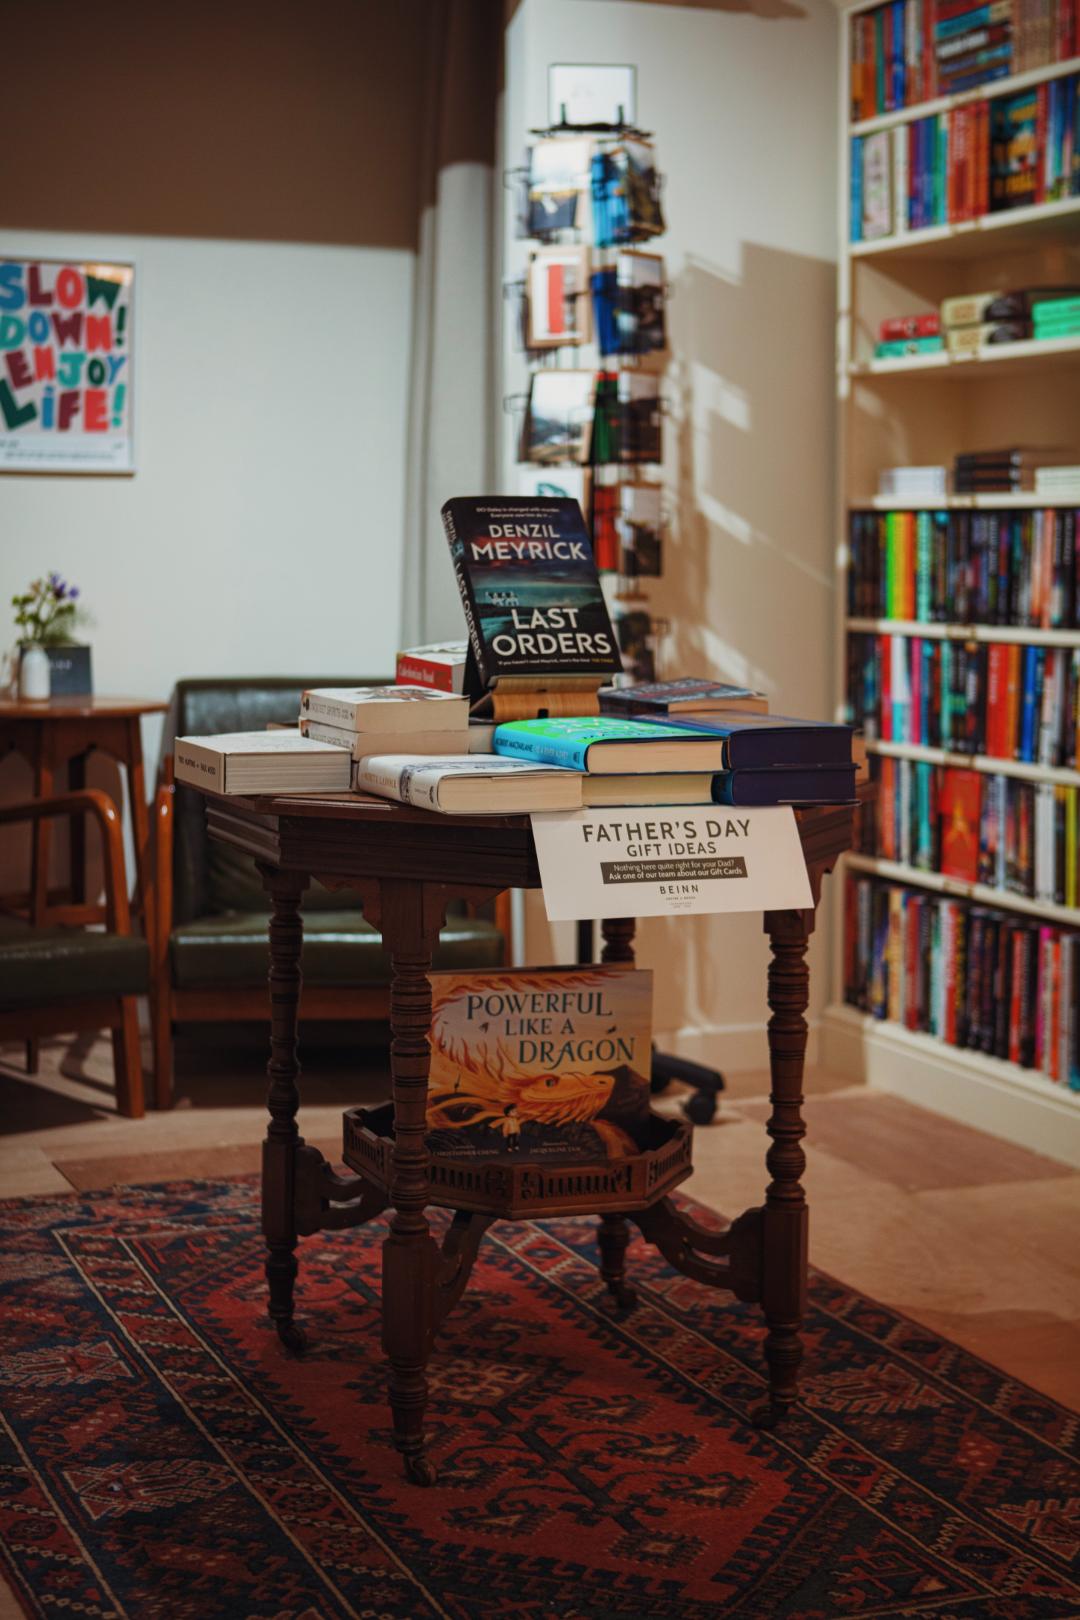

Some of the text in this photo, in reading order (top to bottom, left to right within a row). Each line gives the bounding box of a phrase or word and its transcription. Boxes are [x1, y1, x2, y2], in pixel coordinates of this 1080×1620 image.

[0, 262, 122, 311] SLOW
[5, 346, 126, 390] ENJOY
[488, 524, 560, 538] DENZIL
[470, 542, 588, 561] MEYRICK
[511, 608, 578, 630] LAST
[463, 600, 482, 662] ORDERS
[492, 633, 612, 656] ORDERS
[582, 819, 750, 843] FATHER'S DAY
[626, 841, 717, 857] GIFT IDEAS
[613, 859, 735, 872] Nothing here quite right for your Dad?
[636, 871, 644, 879] of
[677, 869, 697, 877] about
[710, 868, 723, 876] Gift
[723, 867, 743, 875] Cards
[660, 884, 699, 895] BEINN
[466, 992, 613, 1020] POWERFUL
[505, 1018, 575, 1036] LIKE A
[519, 1036, 635, 1070] DRAGON
